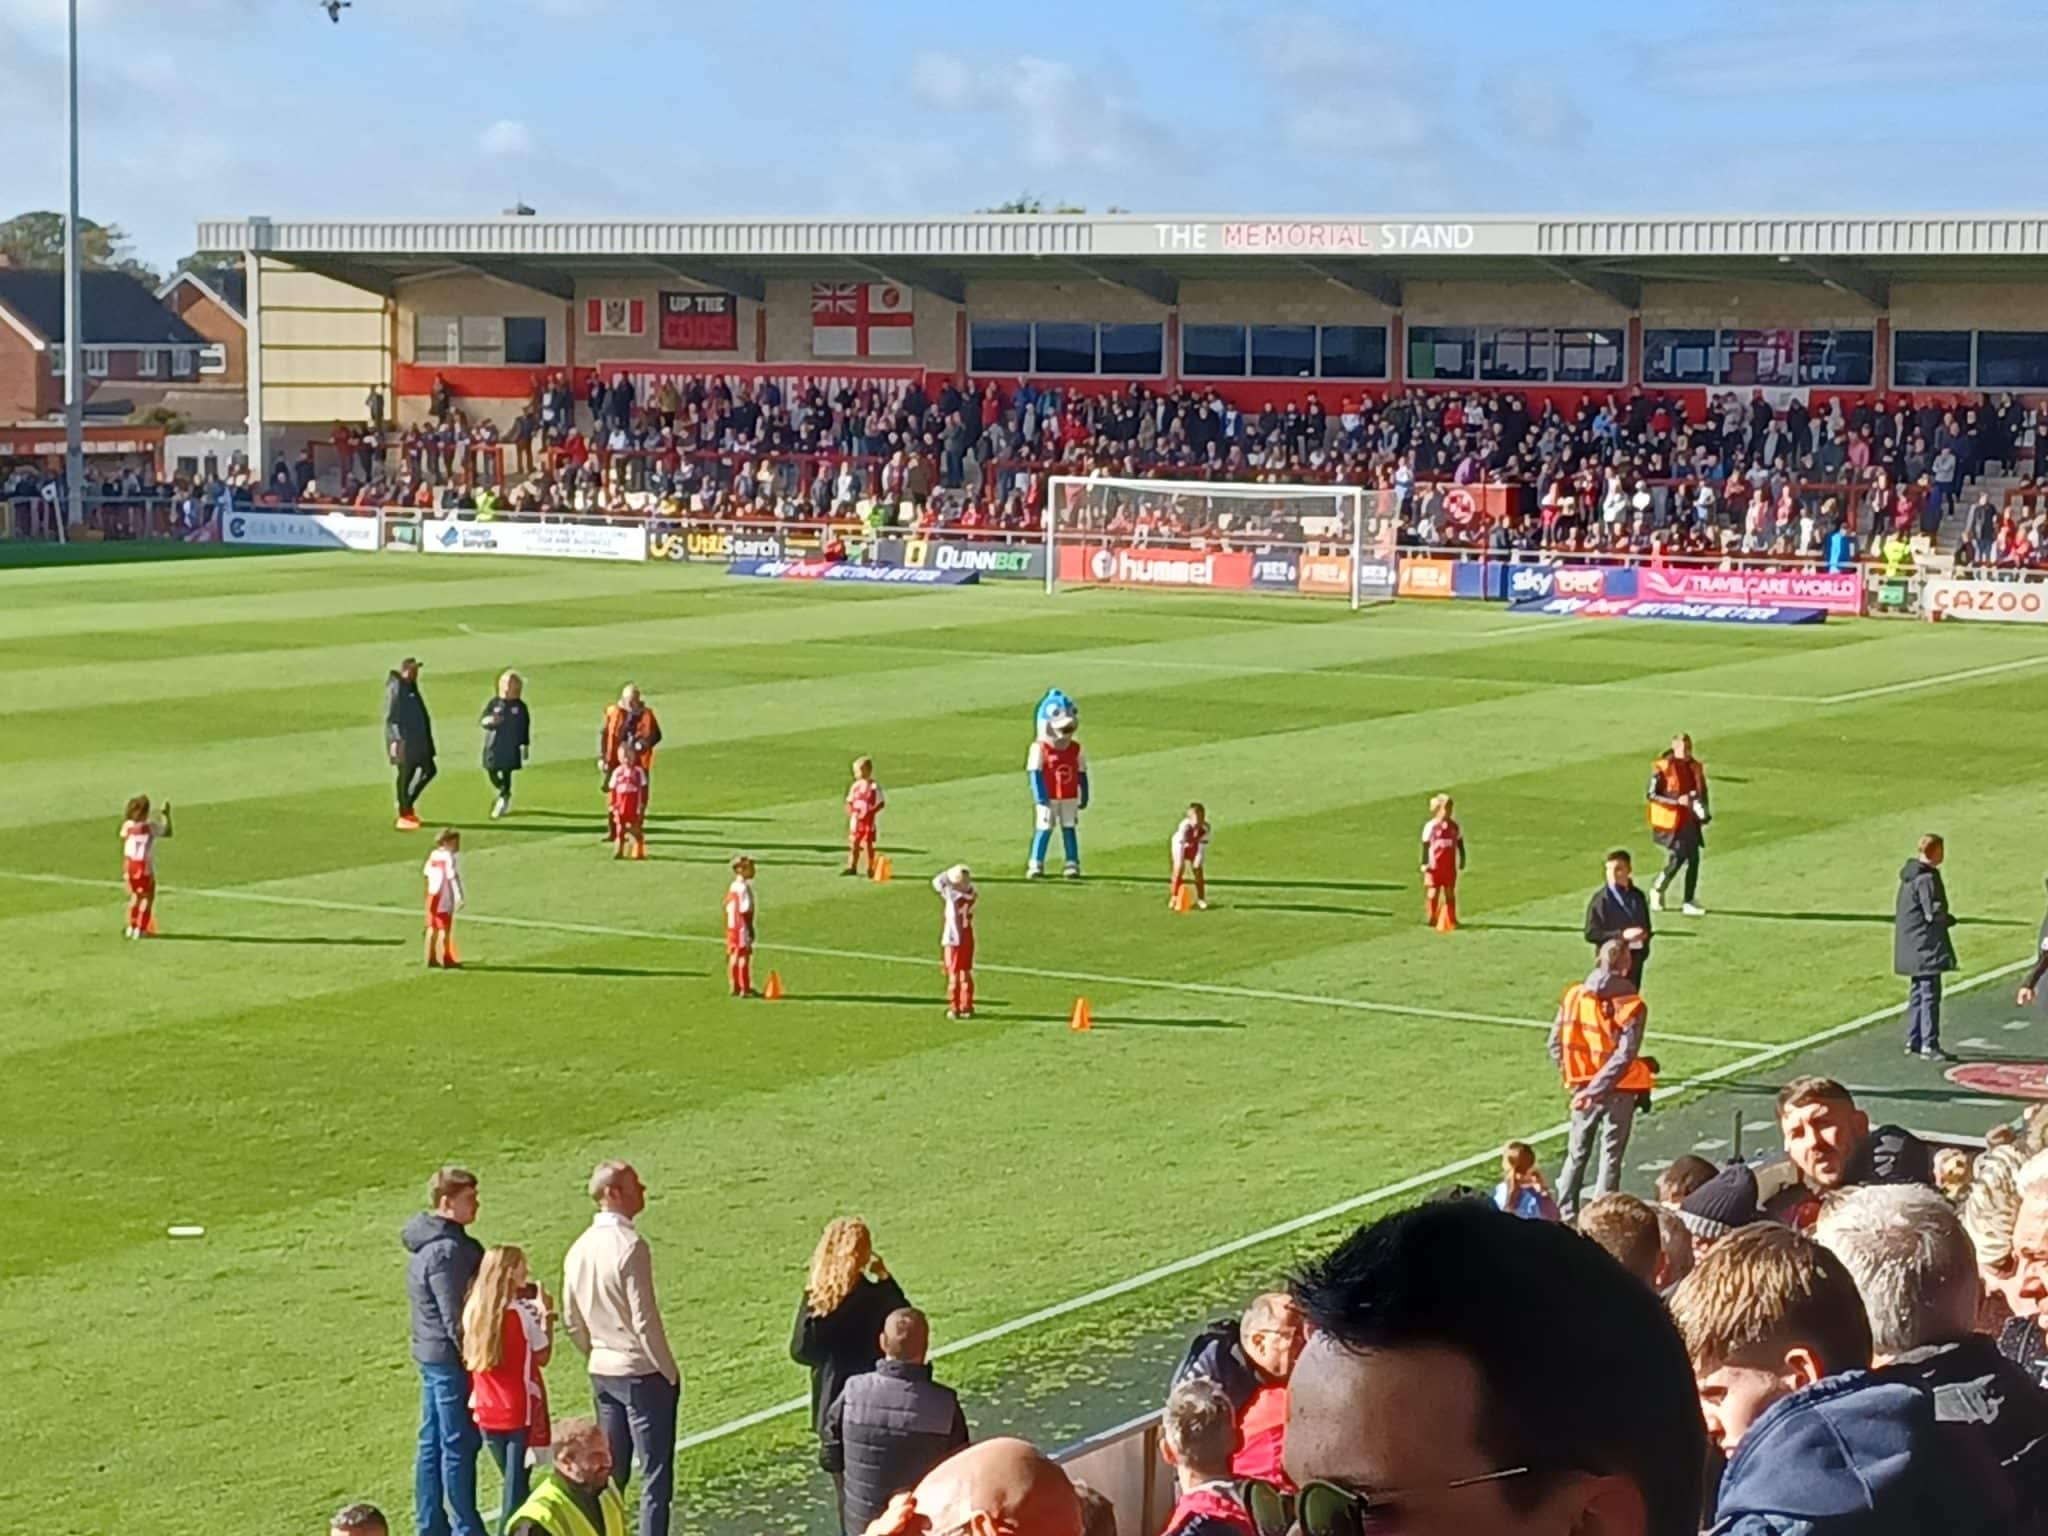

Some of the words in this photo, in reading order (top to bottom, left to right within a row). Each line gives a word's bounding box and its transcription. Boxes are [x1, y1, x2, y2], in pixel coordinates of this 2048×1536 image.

[1155, 224, 1207, 249] THE
[1223, 223, 1370, 247] MEMORIAL
[1379, 224, 1474, 249] STAND
[669, 296, 692, 312] UP
[695, 296, 726, 313] THE
[1119, 550, 1214, 584] hummel
[1512, 568, 1553, 595] sky
[1791, 579, 1856, 597] WORLD
[1934, 588, 2042, 612] CAZOO
